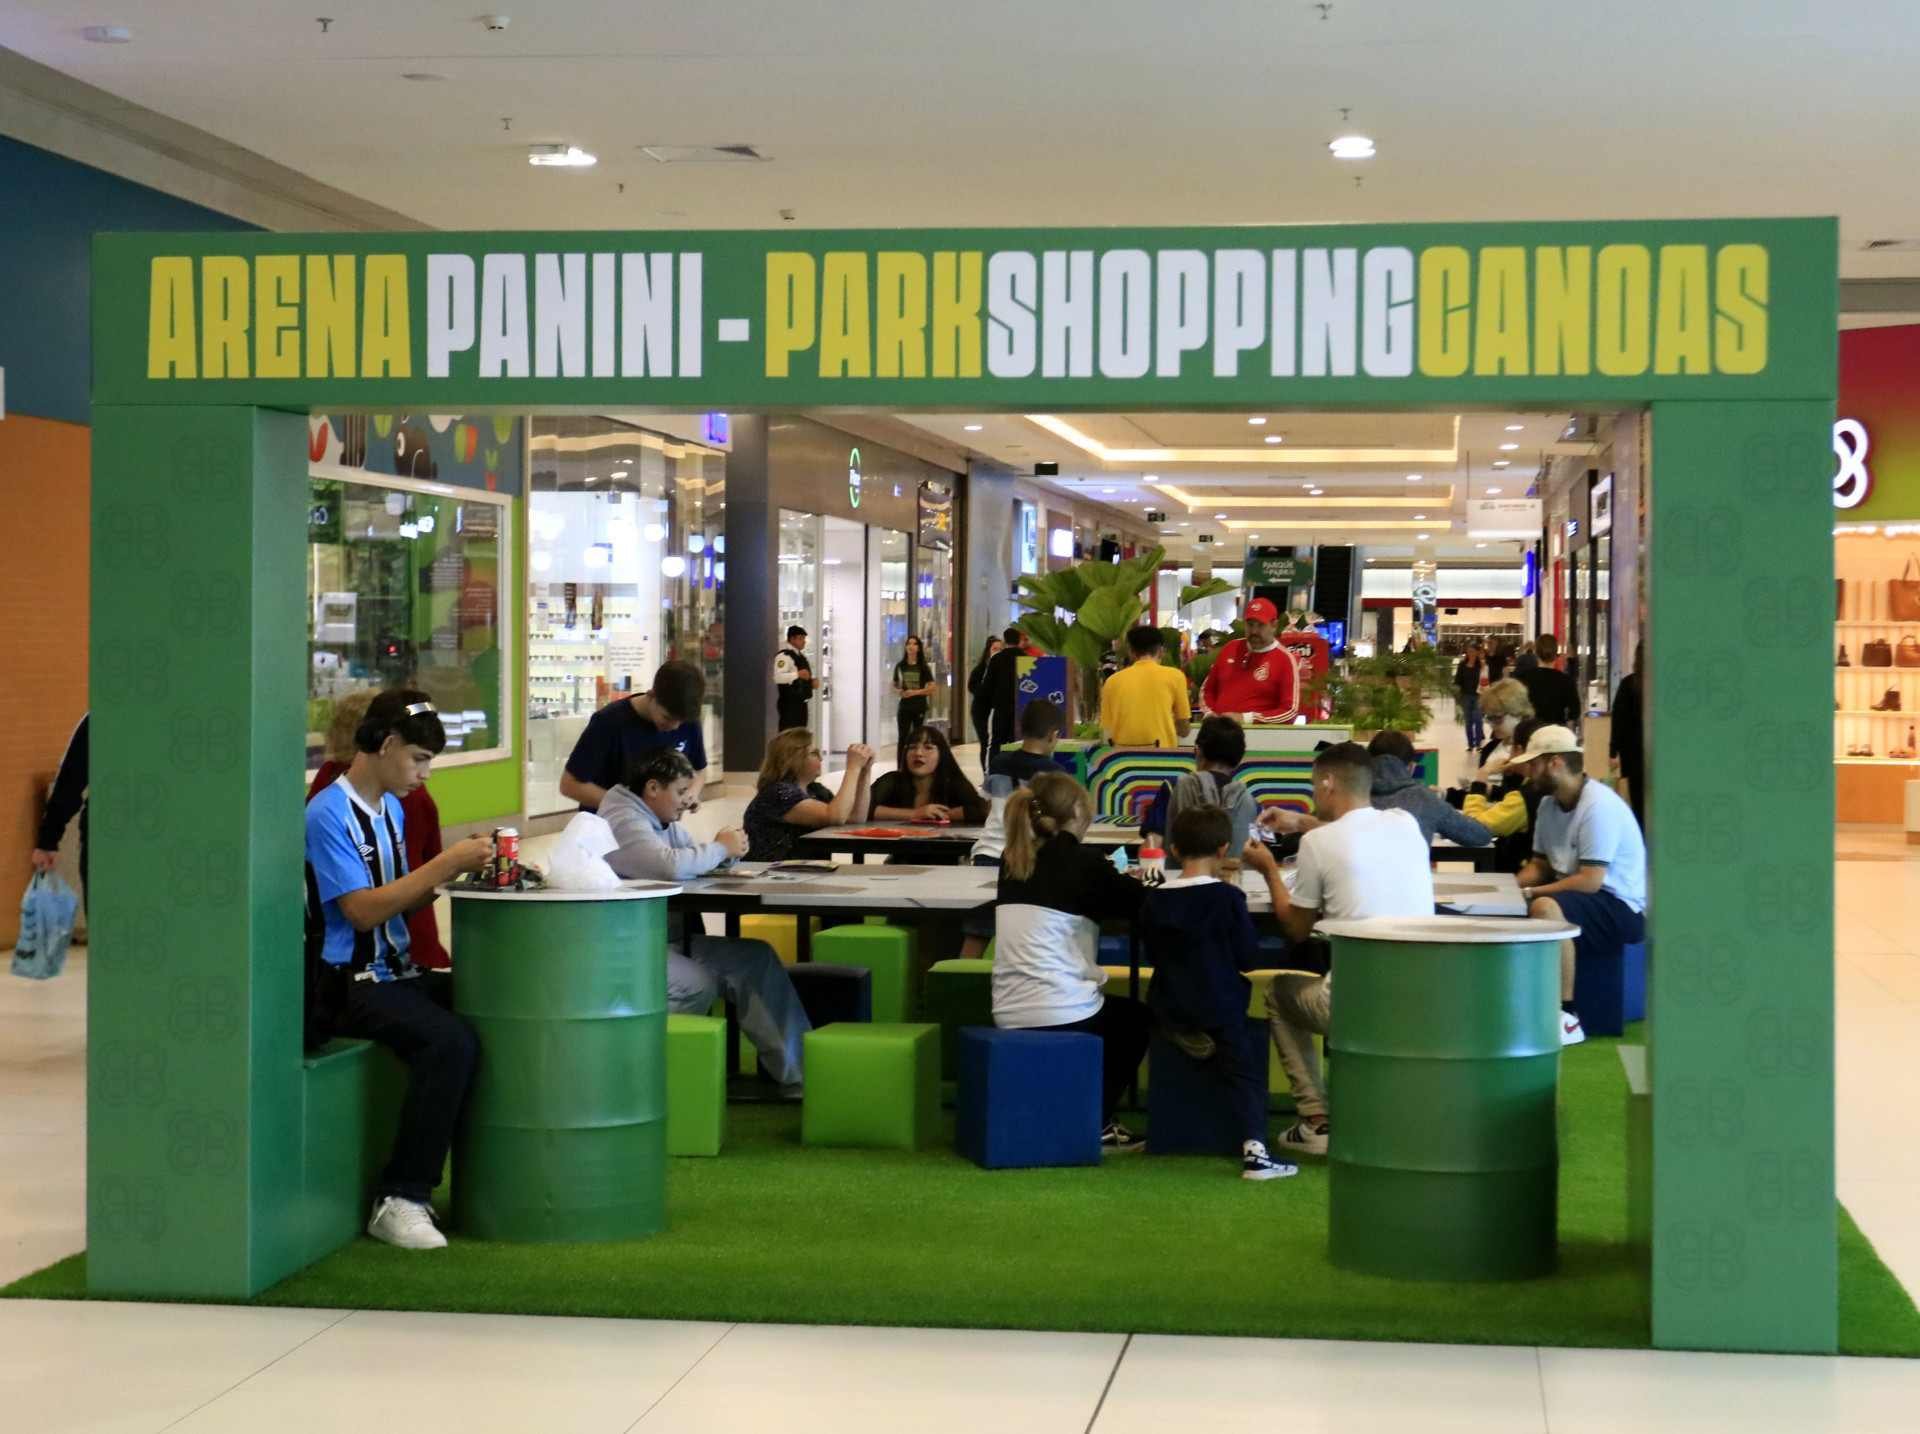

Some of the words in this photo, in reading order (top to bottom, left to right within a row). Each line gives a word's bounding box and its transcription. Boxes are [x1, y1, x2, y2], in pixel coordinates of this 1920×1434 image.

[149, 255, 410, 378] ARENA
[428, 253, 702, 377] PANINI
[719, 319, 749, 341] -
